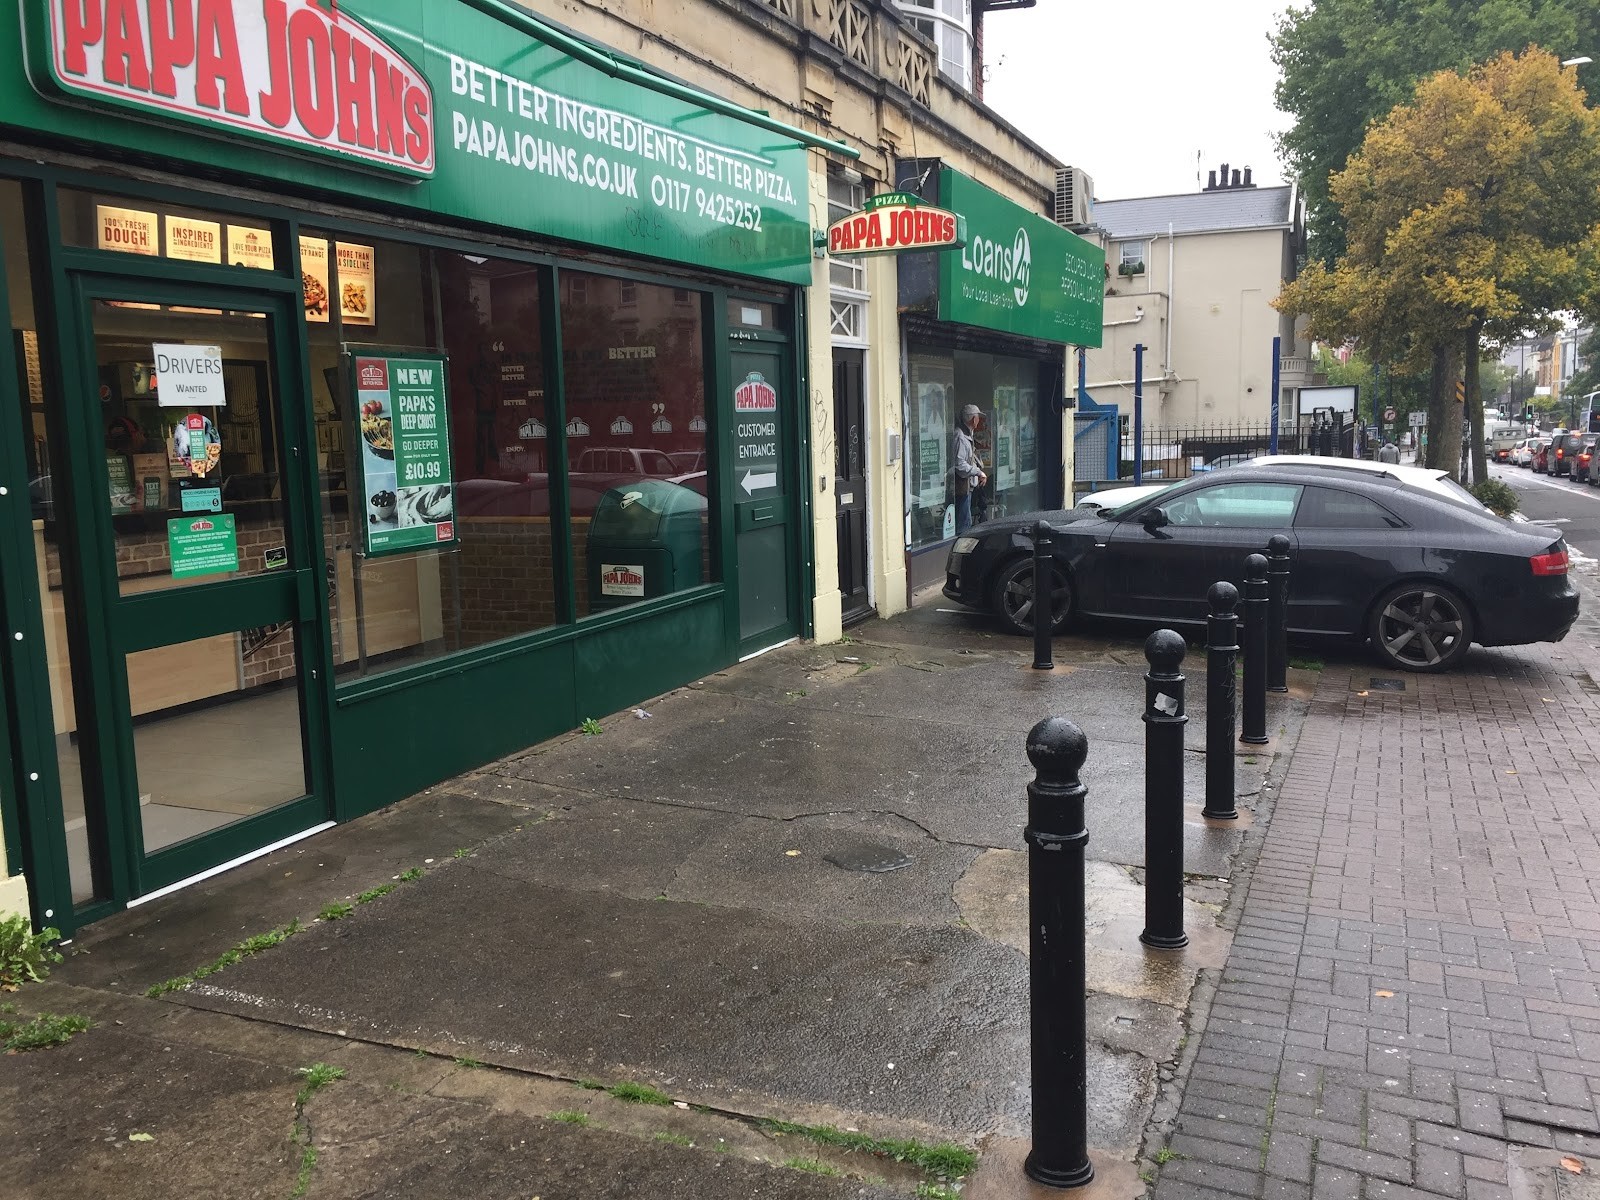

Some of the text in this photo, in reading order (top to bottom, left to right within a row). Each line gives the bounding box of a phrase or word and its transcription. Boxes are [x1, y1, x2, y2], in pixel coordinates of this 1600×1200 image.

[62, 0, 432, 165] PAPA JOHN'S
[450, 55, 797, 206] BETTER INGREDIENTS. BETTER PIZZA.
[452, 110, 639, 200] PAPAJOHNS.CO.UK
[650, 174, 691, 214] 0117
[694, 187, 763, 234] 9425252
[875, 194, 907, 207] PIZZA
[125, 220, 147, 231] FRESH
[830, 209, 954, 251] PAPA JOHN'S
[104, 226, 147, 246] DOUGH
[172, 226, 214, 243] INSPIRED
[177, 239, 214, 250] INGREDIENTS
[258, 246, 271, 254] PIZZA
[337, 248, 370, 261] MORE THAN
[343, 258, 370, 270] SIDELINE
[608, 346, 656, 359] BETTER
[396, 368, 433, 385] NEW
[398, 395, 436, 412] PAPA'S
[736, 384, 754, 409] PAPA
[400, 413, 437, 430] DEEP CRUST
[737, 422, 776, 438] CUSTOMER
[402, 439, 439, 451] GO DEEPER
[739, 443, 776, 459] ENTRANCE
